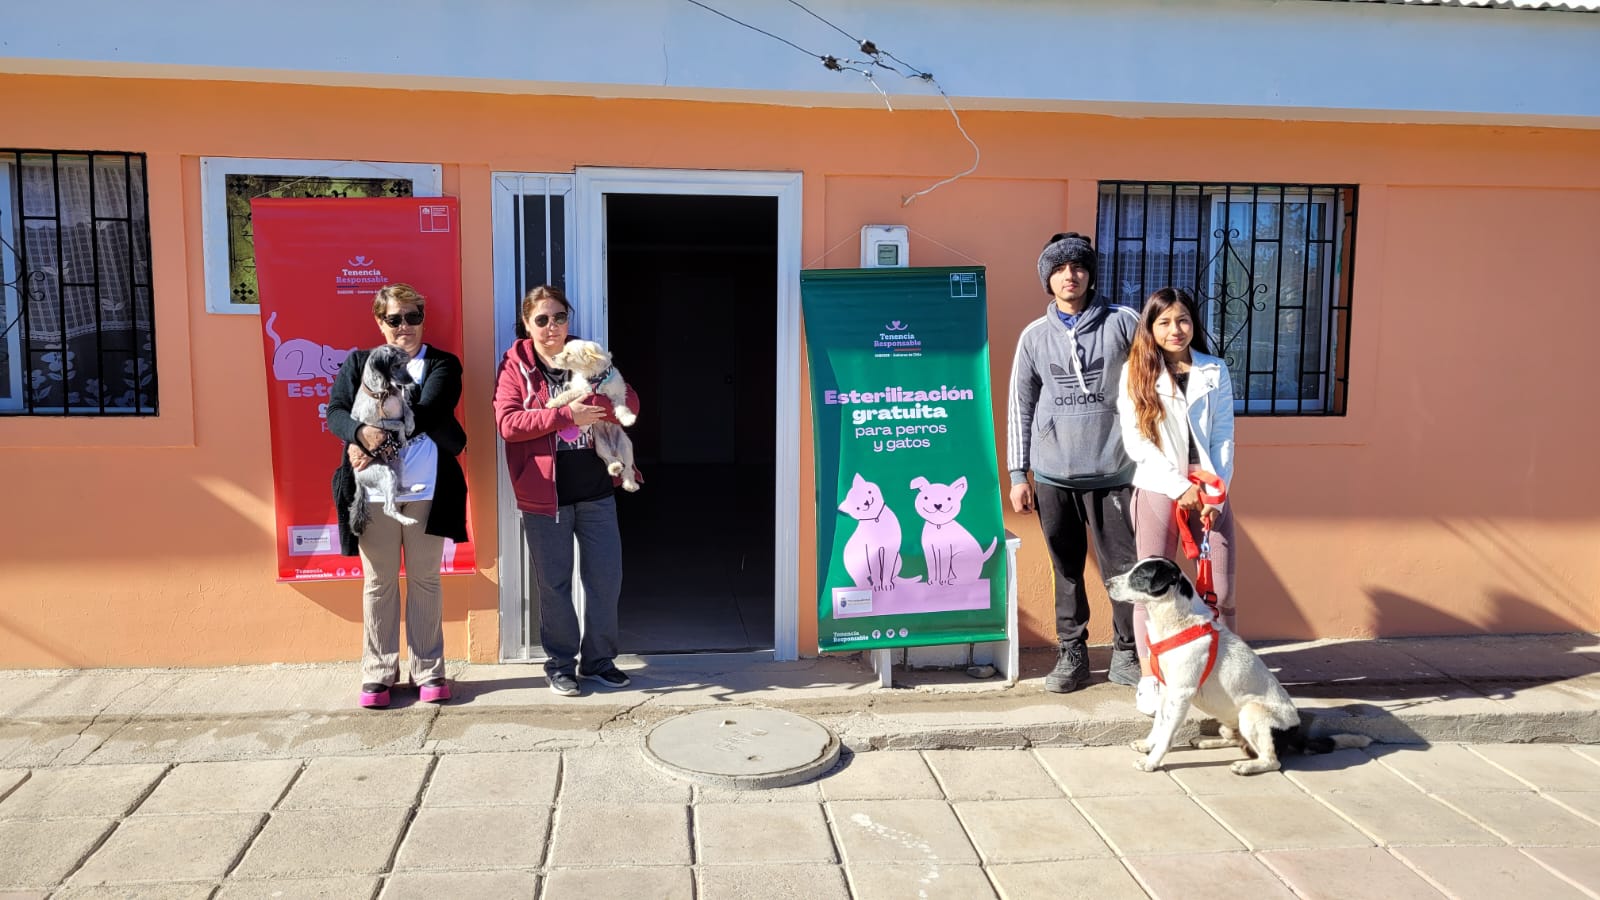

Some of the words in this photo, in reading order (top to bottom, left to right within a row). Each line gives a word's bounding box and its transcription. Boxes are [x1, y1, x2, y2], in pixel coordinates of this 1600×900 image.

[341, 268, 381, 276] Tenencia
[336, 276, 389, 284] Responsable
[879, 332, 915, 340] Tenencia
[874, 340, 922, 348] Responsable
[824, 385, 974, 404] Esterilización
[1054, 392, 1105, 406] adidas
[852, 402, 948, 425] gratuita
[855, 425, 893, 438] para
[895, 424, 947, 437] perros
[873, 440, 884, 452] y
[886, 437, 931, 452] gatos
